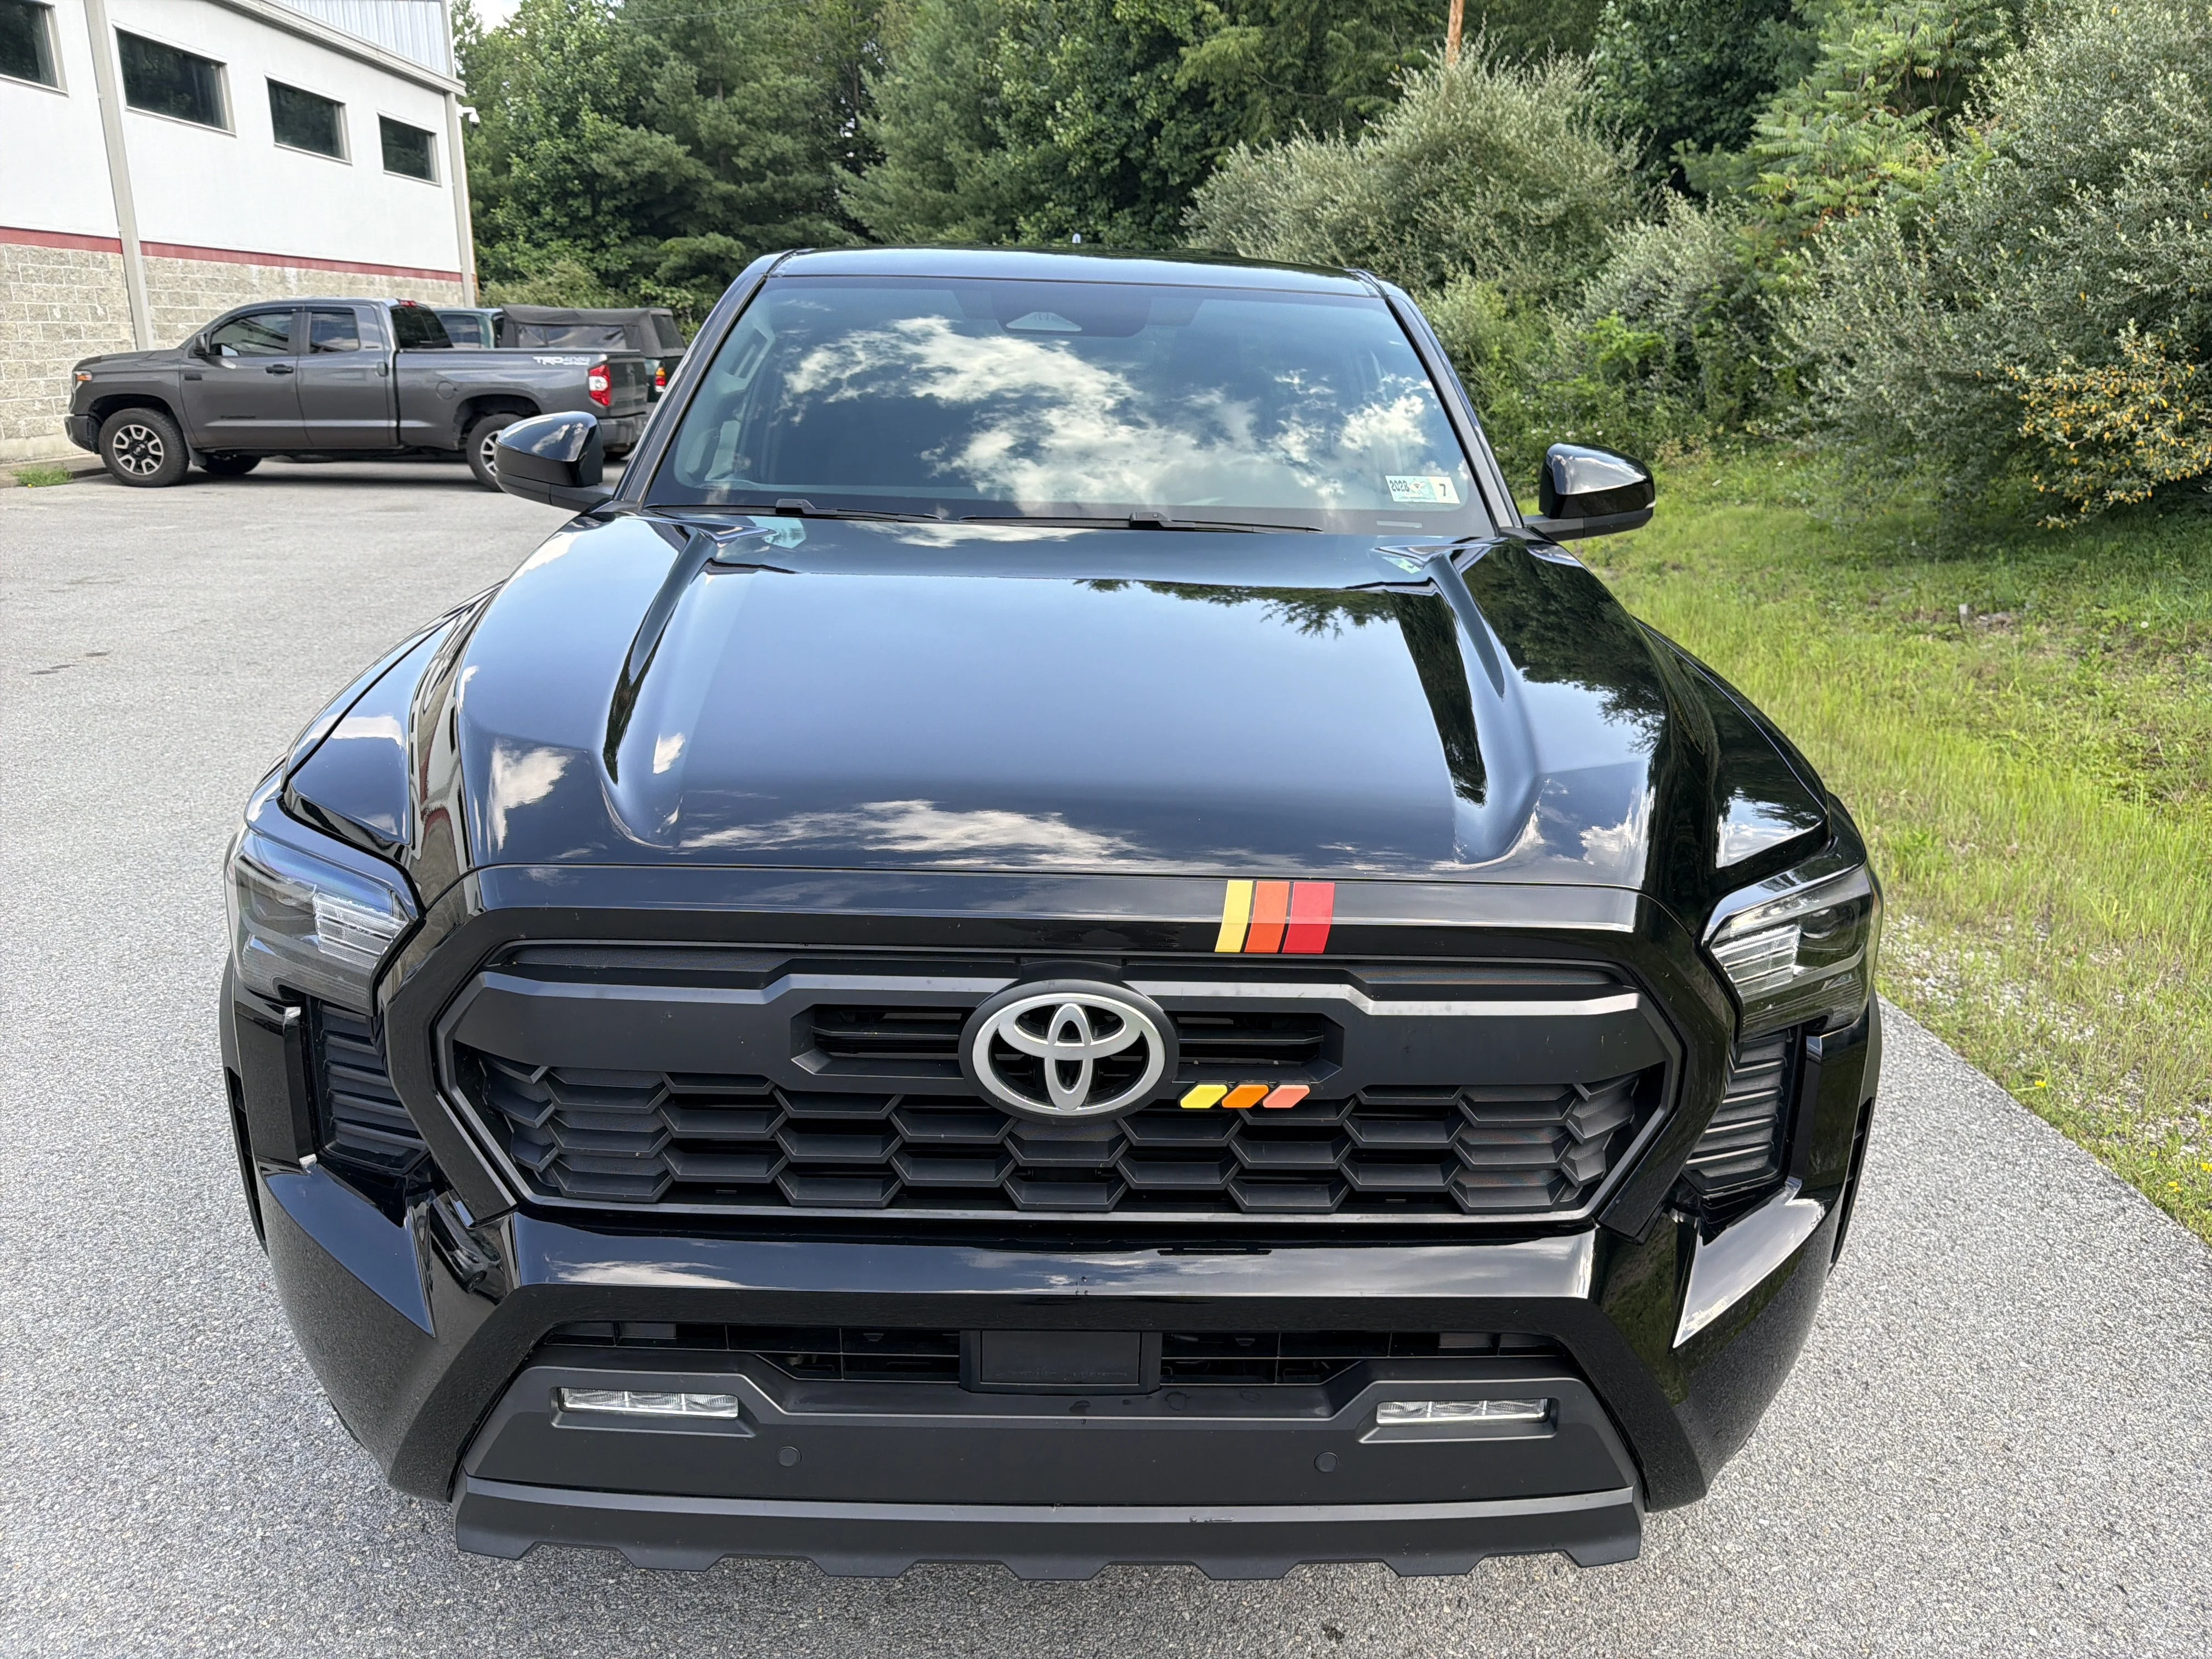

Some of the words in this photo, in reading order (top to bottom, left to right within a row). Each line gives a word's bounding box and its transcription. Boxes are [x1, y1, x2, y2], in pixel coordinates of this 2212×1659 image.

[533, 356, 563, 365] TRD
[1389, 480, 1410, 492] 2028
[1438, 483, 1447, 497] 7
